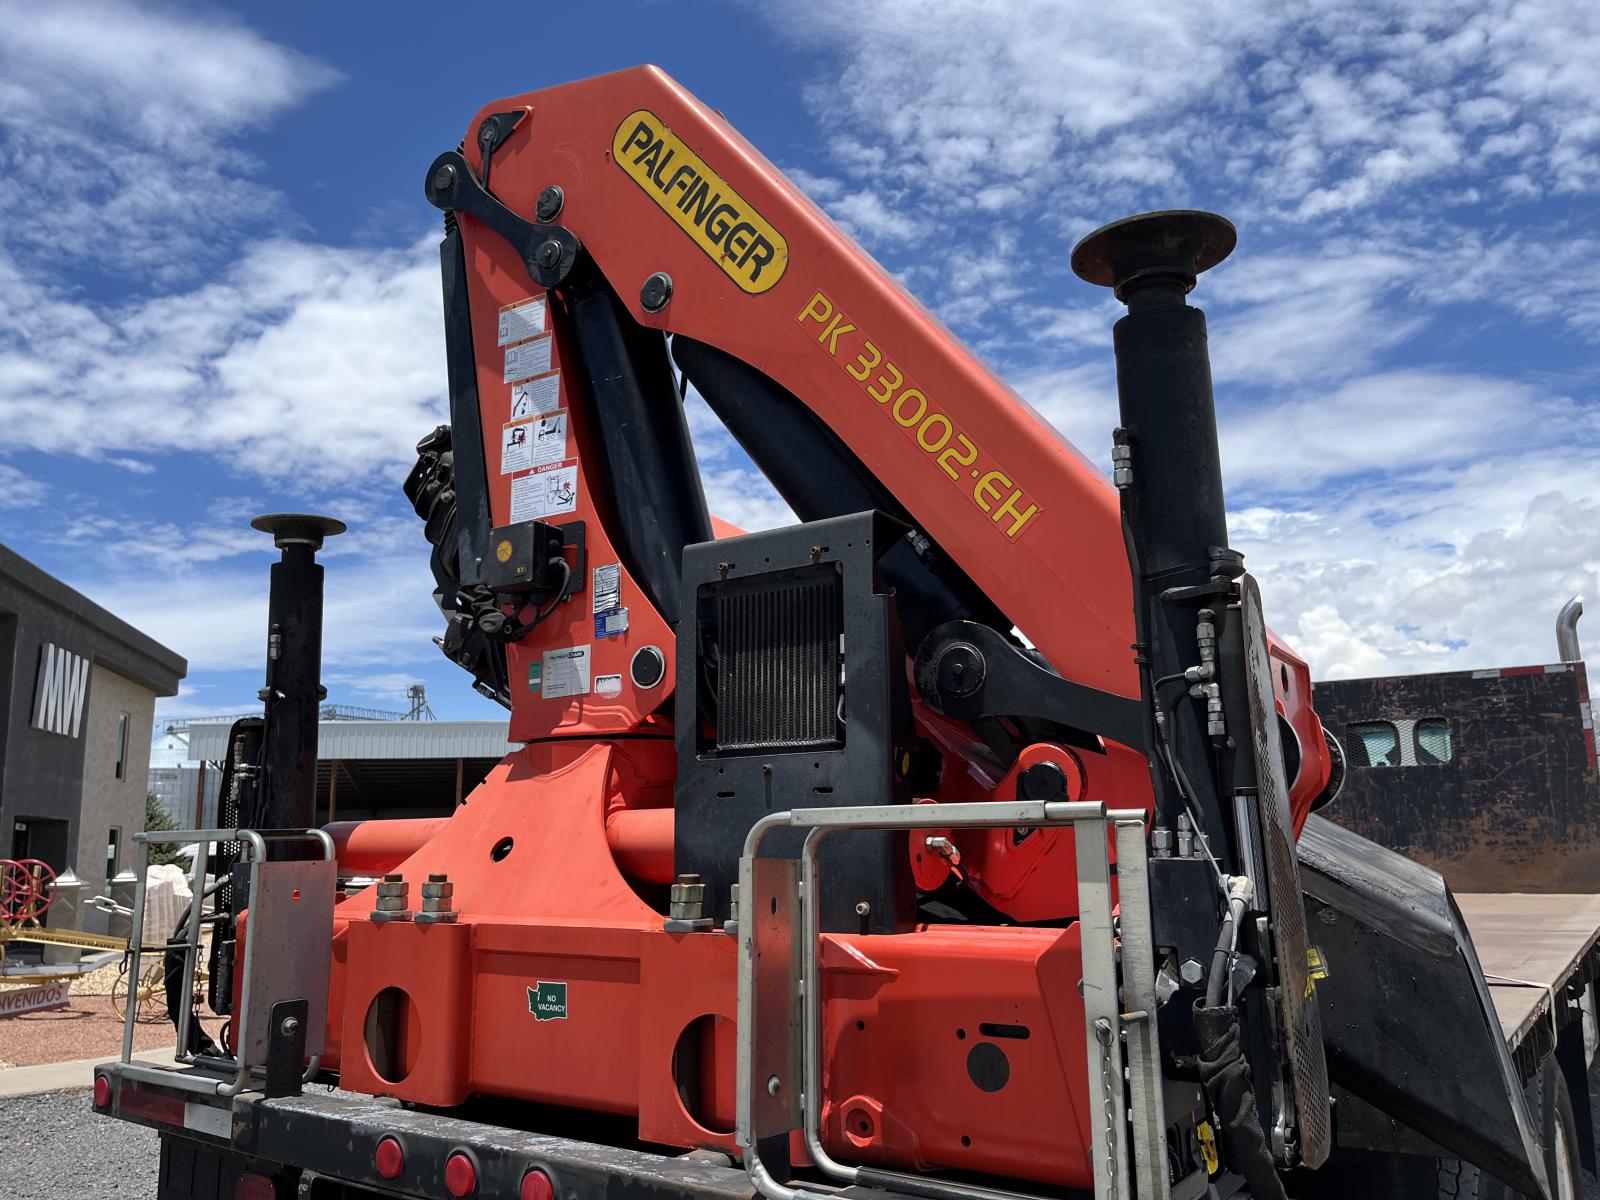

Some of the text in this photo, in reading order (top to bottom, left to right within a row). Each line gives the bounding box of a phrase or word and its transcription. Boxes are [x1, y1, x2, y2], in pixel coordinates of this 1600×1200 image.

[621, 121, 775, 284] PALFINGER
[797, 291, 857, 357] PK
[537, 462, 563, 473] DANGER
[31, 642, 89, 739] MW
[538, 1003, 565, 1012] VACANCY
[547, 994, 556, 1002] NO
